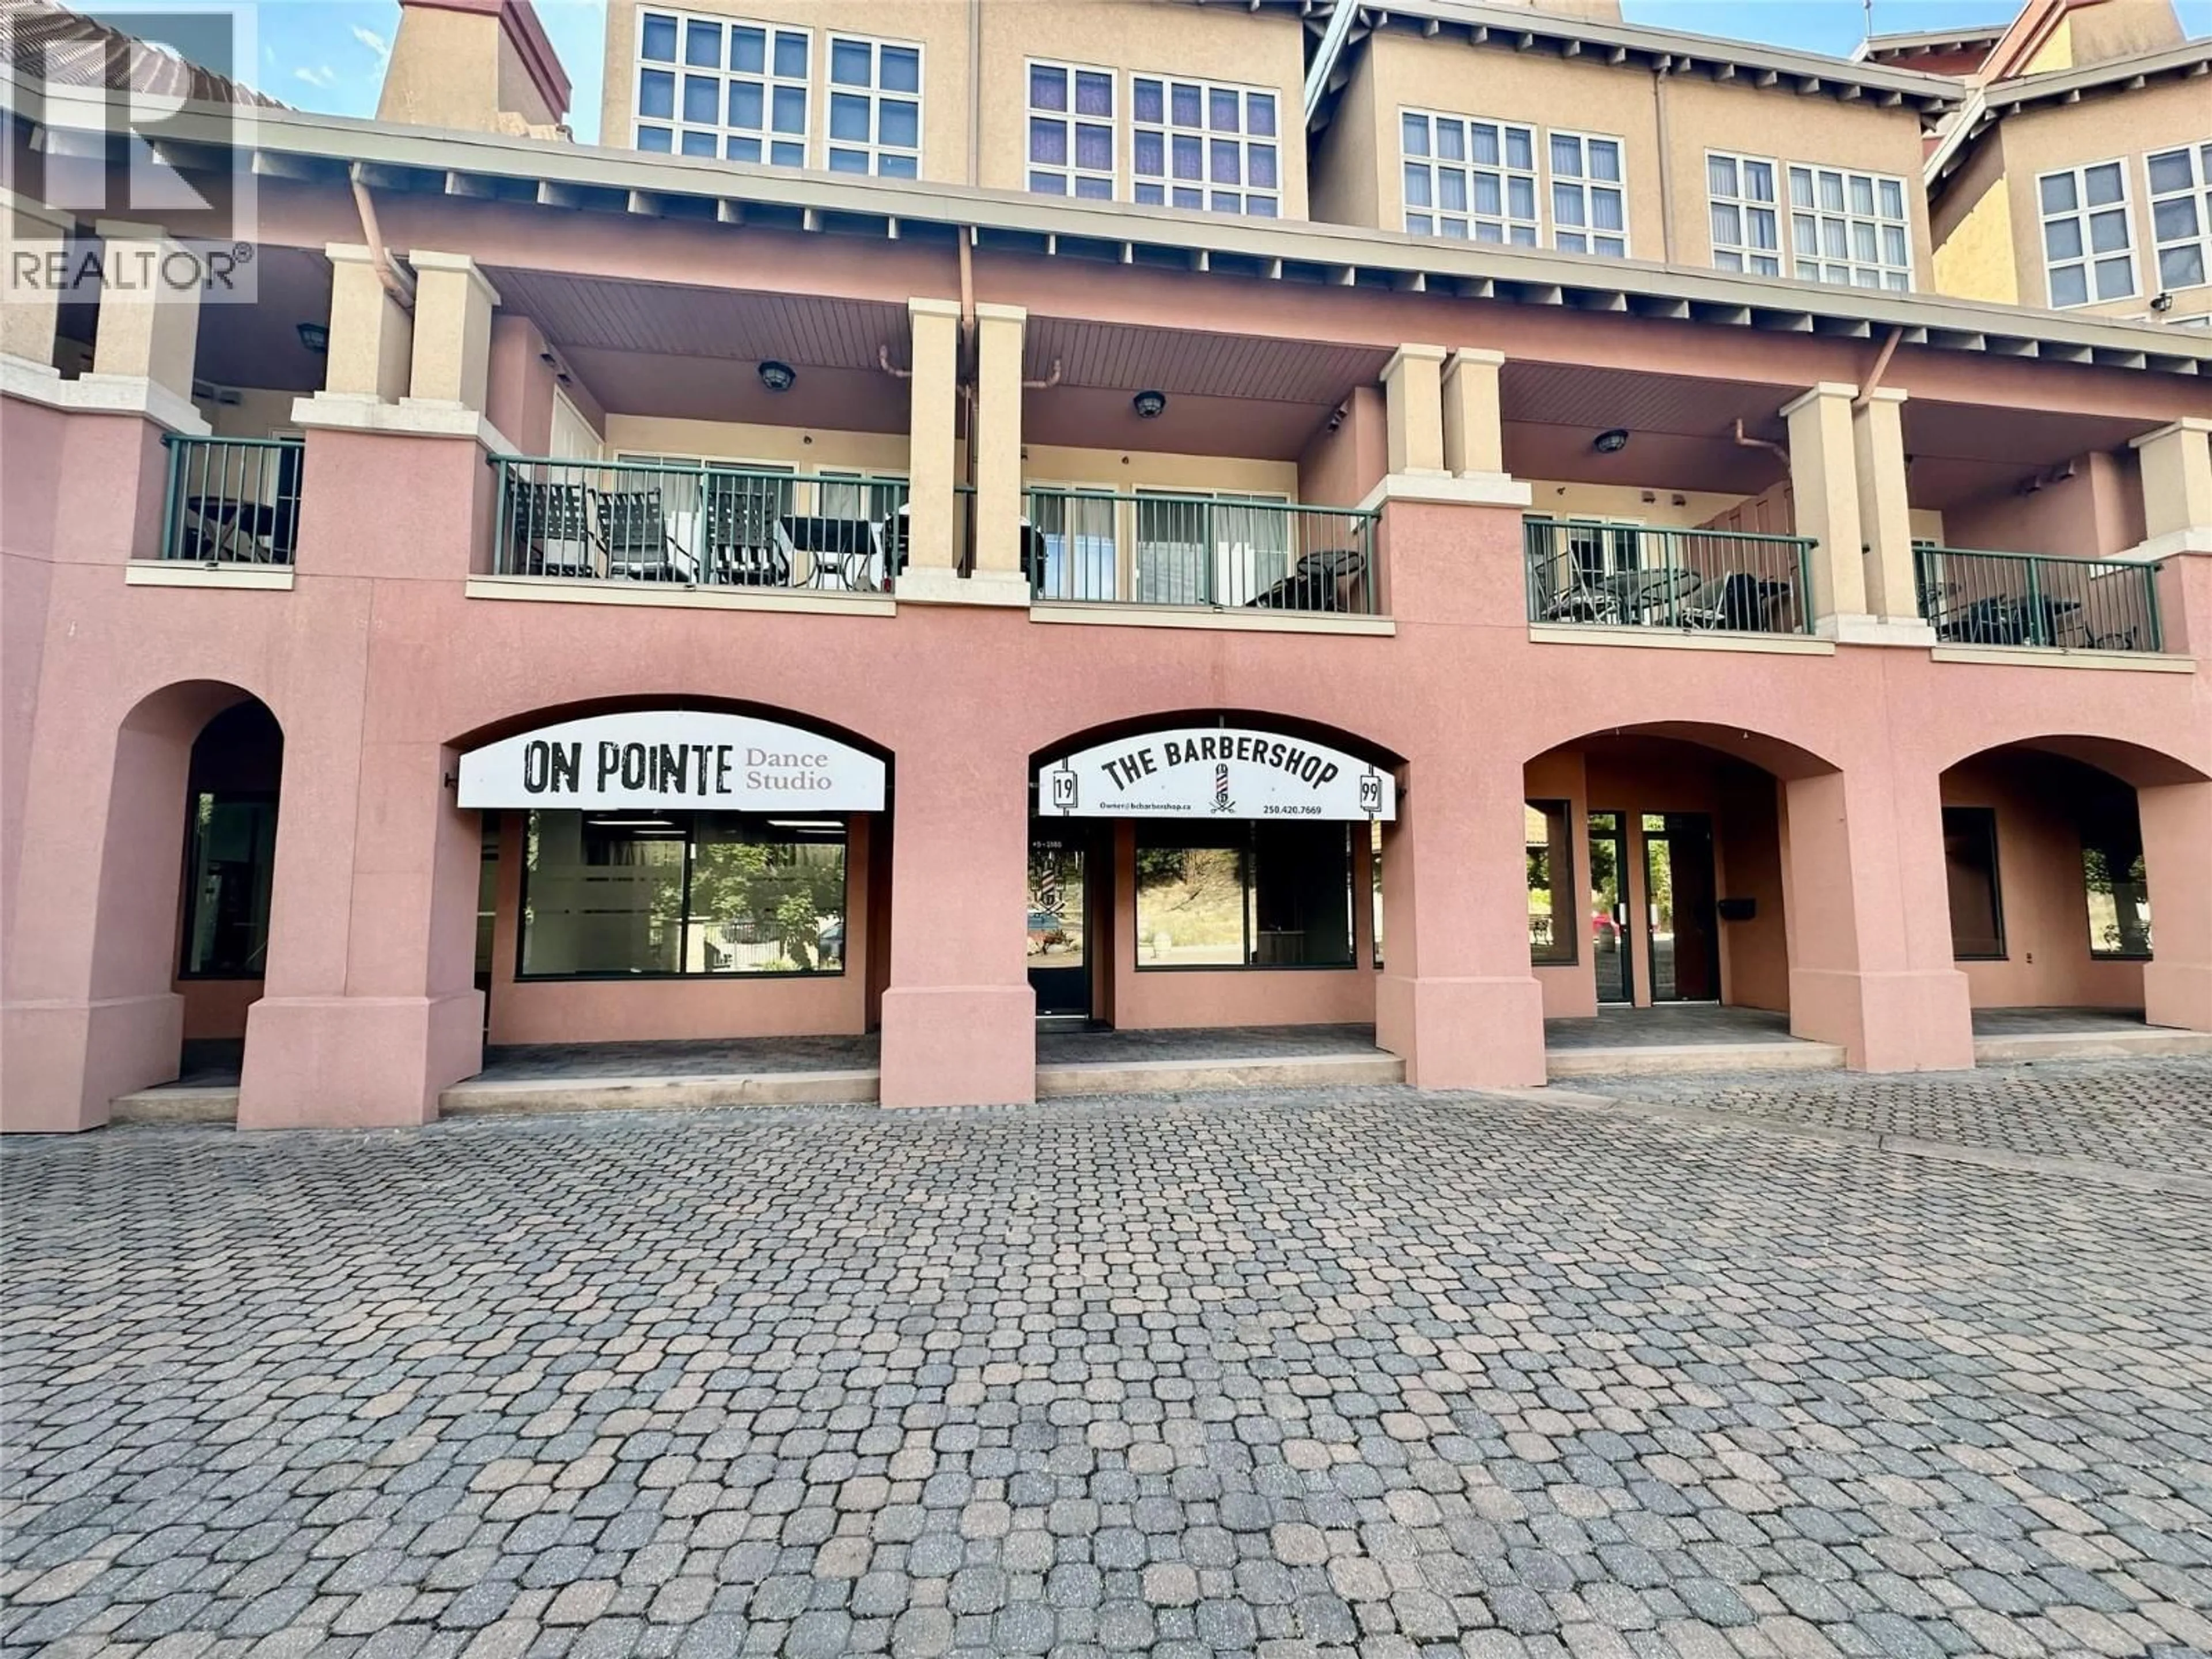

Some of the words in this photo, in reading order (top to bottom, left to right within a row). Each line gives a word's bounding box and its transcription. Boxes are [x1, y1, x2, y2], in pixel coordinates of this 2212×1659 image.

[745, 748, 828, 767] Dance
[1101, 748, 1157, 791] THE
[1164, 736, 1339, 789] BARBERSHOP
[524, 740, 582, 793] ON
[597, 741, 733, 796] POINTE
[747, 771, 832, 790] Studio
[1056, 778, 1073, 798] 19
[1362, 782, 1378, 801] 99
[1263, 805, 1321, 815] 250.420.7669
